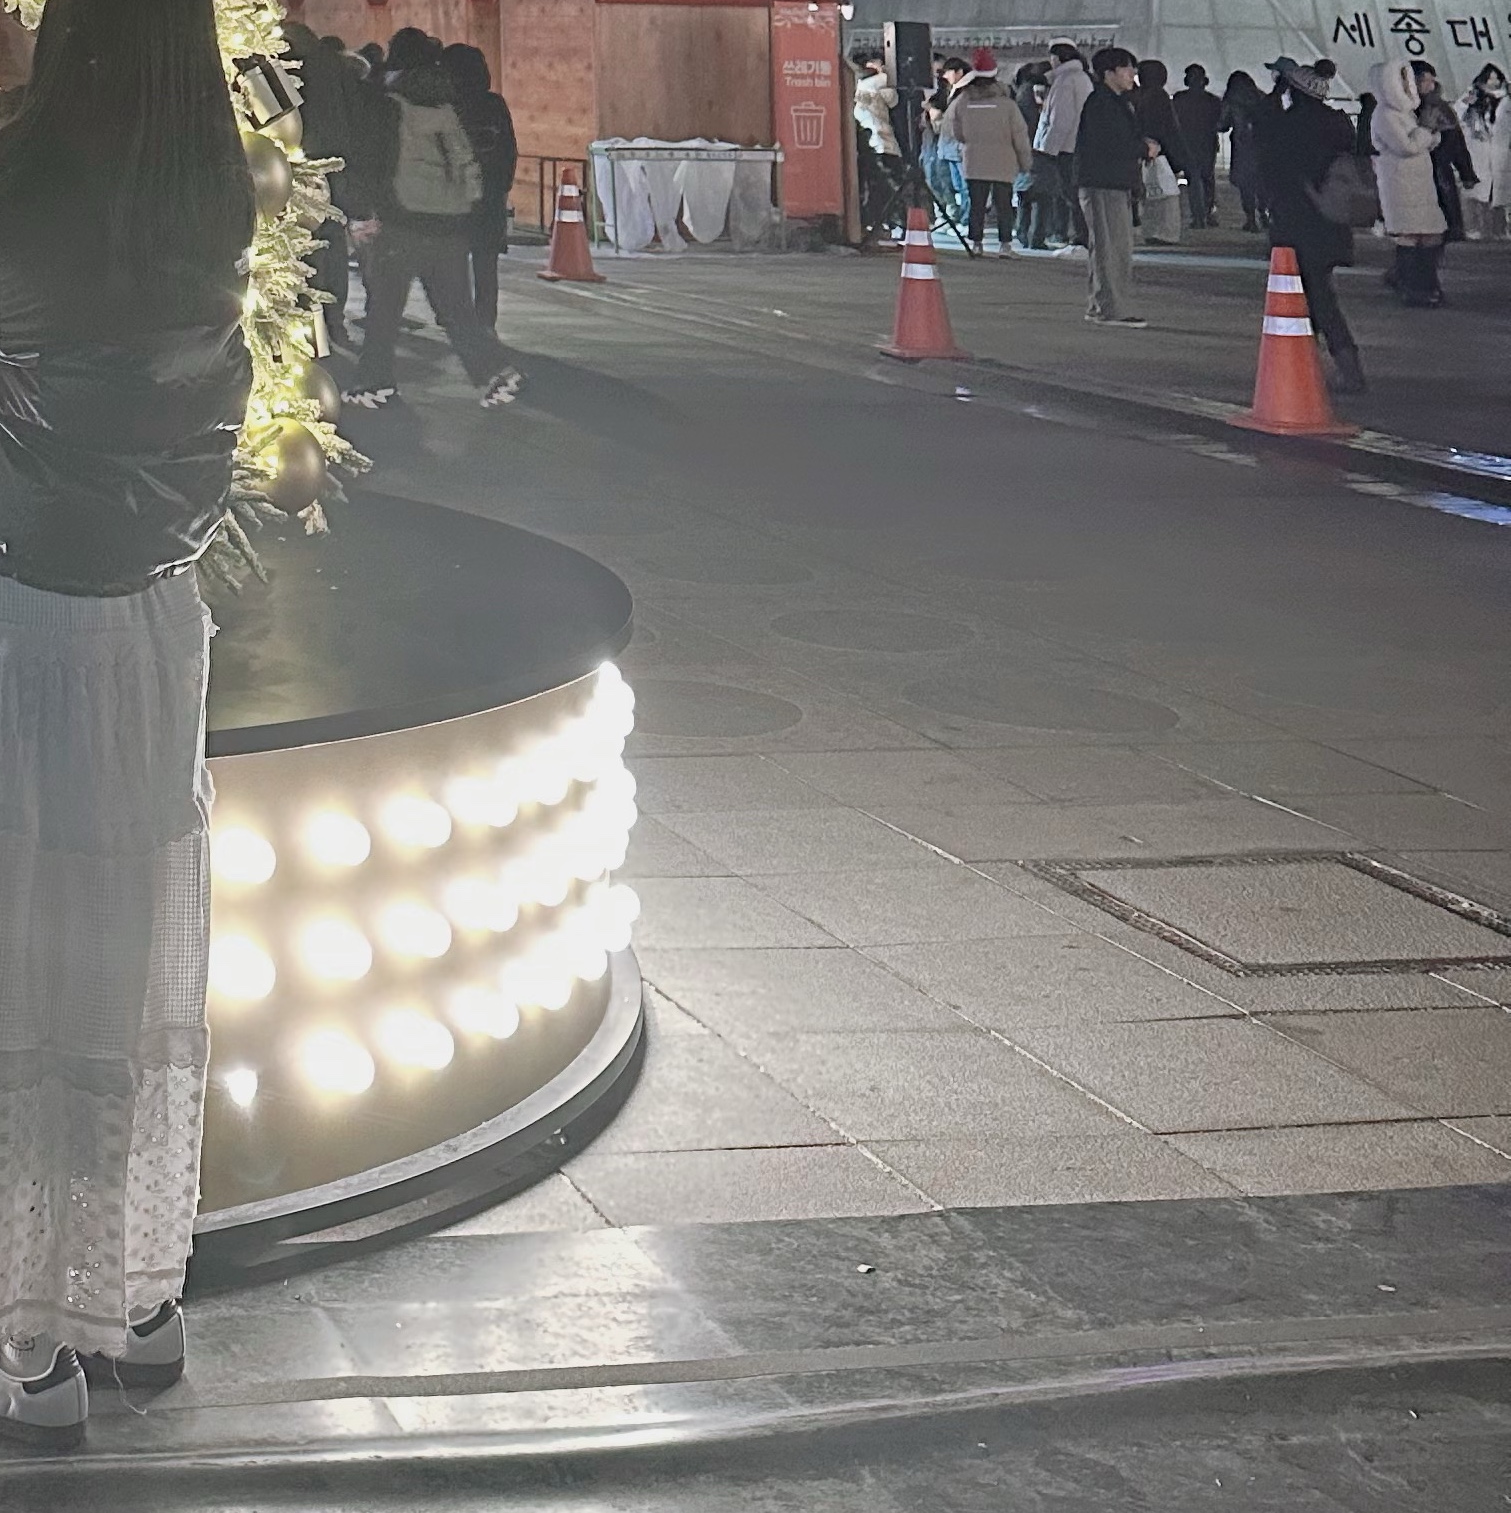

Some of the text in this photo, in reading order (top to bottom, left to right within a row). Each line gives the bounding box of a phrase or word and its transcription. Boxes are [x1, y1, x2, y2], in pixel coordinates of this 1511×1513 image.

[1333, 8, 1511, 55] 세종대
[782, 60, 832, 75] 쓰레기통
[785, 76, 831, 87] Trash bin
